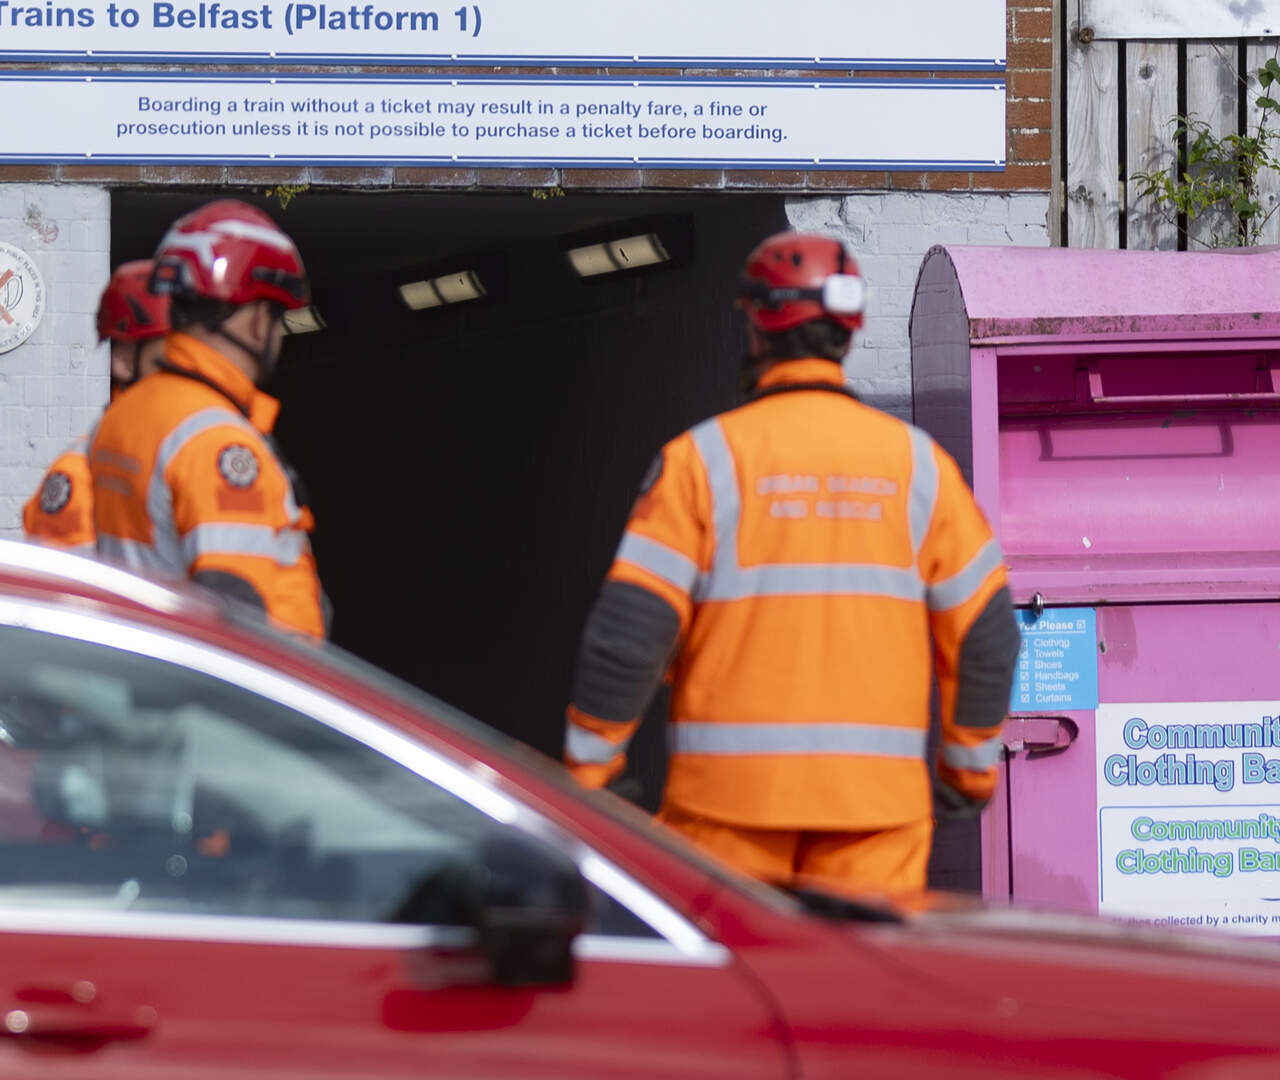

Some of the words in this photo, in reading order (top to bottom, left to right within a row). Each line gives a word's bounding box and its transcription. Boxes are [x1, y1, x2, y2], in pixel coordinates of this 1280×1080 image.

[106, 2, 140, 28] to
[153, 2, 273, 30] Belfast
[284, 3, 439, 36] (Platform
[454, 5, 482, 38] 1)
[138, 96, 220, 116] Boarding
[227, 100, 236, 113] a
[243, 97, 285, 113] train
[290, 97, 359, 113] without
[364, 102, 375, 113] a
[380, 98, 432, 114] ticket
[437, 102, 476, 118] may
[481, 99, 533, 115] result
[538, 99, 554, 115] in
[559, 103, 570, 115] a
[576, 100, 642, 119] penalty
[647, 100, 688, 118] fare,
[693, 104, 704, 116] a
[709, 100, 743, 117] fine
[748, 105, 768, 117] or
[116, 120, 226, 139] prosecution
[232, 120, 292, 136] unless
[297, 120, 309, 136] it
[314, 120, 329, 136] is
[335, 122, 364, 136] not
[370, 121, 446, 140] possible
[451, 122, 470, 137] to
[475, 122, 560, 141] purchase
[565, 126, 576, 138] a
[582, 123, 633, 138] ticket
[638, 123, 697, 139] before
[702, 124, 788, 143] boarding.
[1040, 621, 1073, 630] Please
[1033, 639, 1070, 648] Clothing
[1034, 649, 1064, 657] Towels
[1034, 660, 1062, 669] Shoes
[1034, 672, 1079, 681] Handbags
[1035, 682, 1066, 691] Sheets
[1035, 694, 1072, 703] Curtains
[1104, 752, 1235, 792] Clothing
[1116, 847, 1234, 878] Clothing
[1206, 915, 1219, 926] by
[1231, 914, 1268, 926] charity
